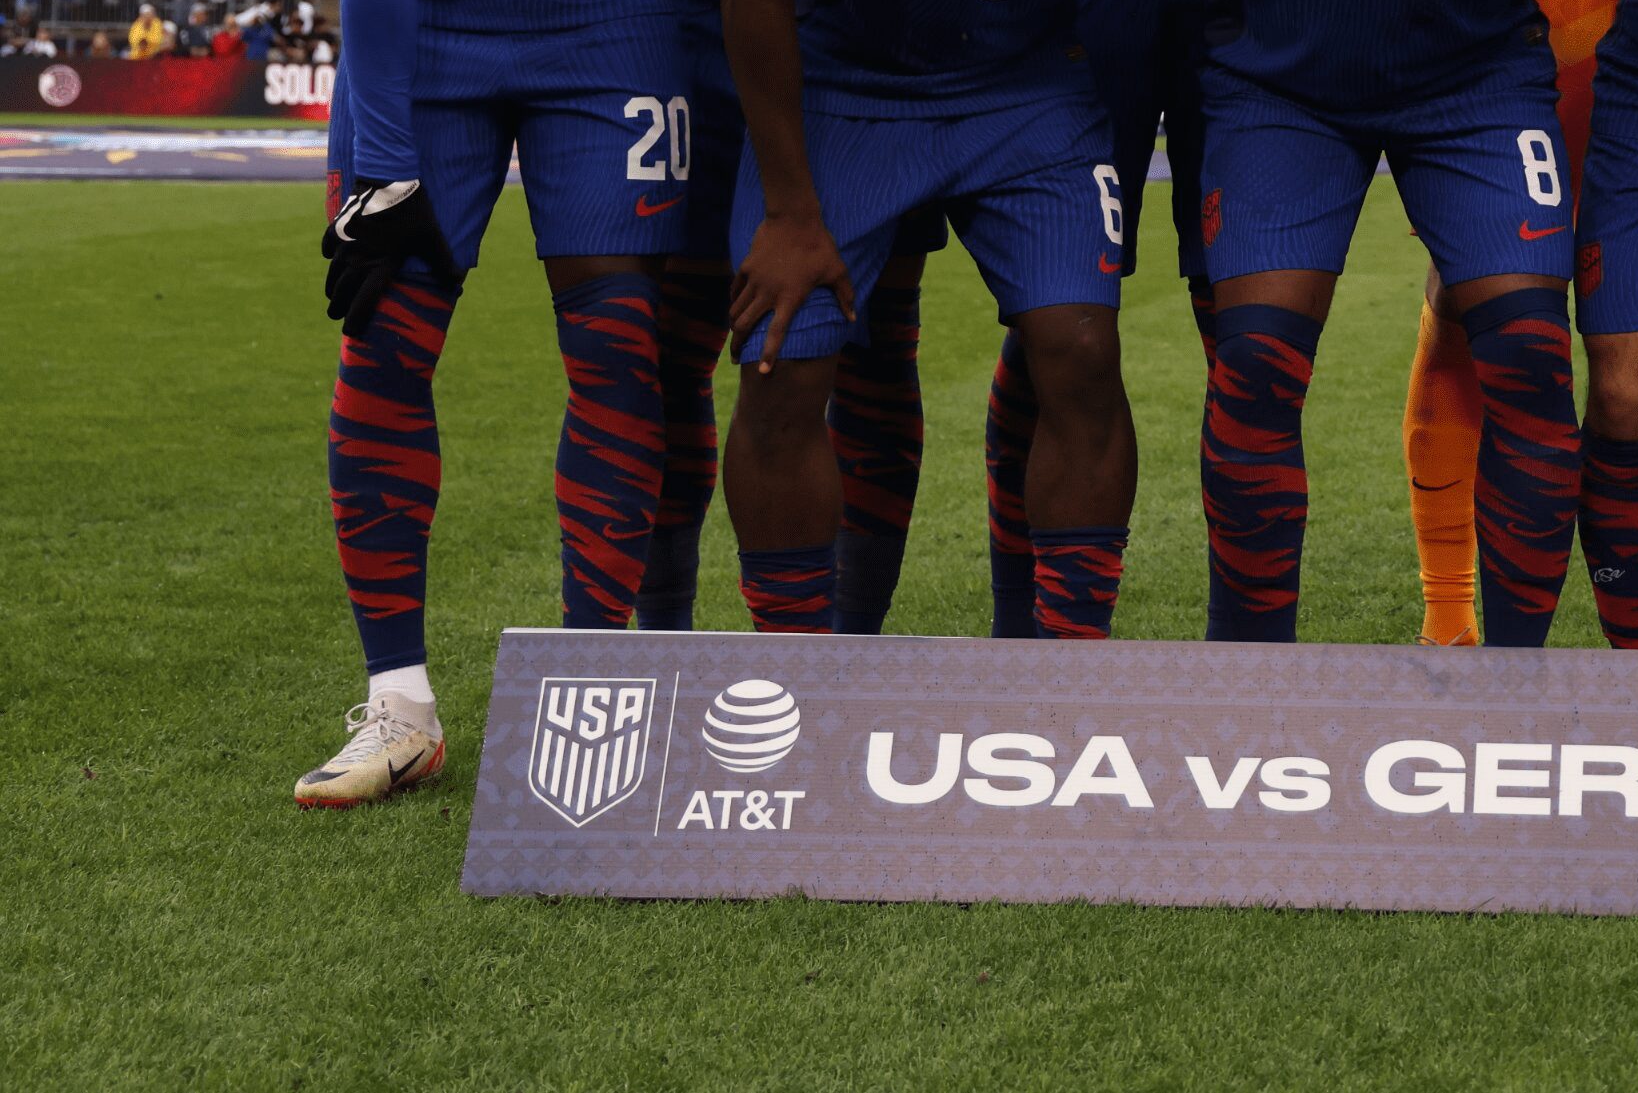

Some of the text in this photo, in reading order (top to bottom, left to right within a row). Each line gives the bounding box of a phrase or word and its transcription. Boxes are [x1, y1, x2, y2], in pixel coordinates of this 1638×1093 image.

[623, 95, 691, 181] 20
[1516, 129, 1562, 207] 8
[1092, 164, 1123, 245] 6
[547, 686, 643, 742] USA
[866, 731, 1155, 808] USA
[676, 789, 806, 831] AT&T
